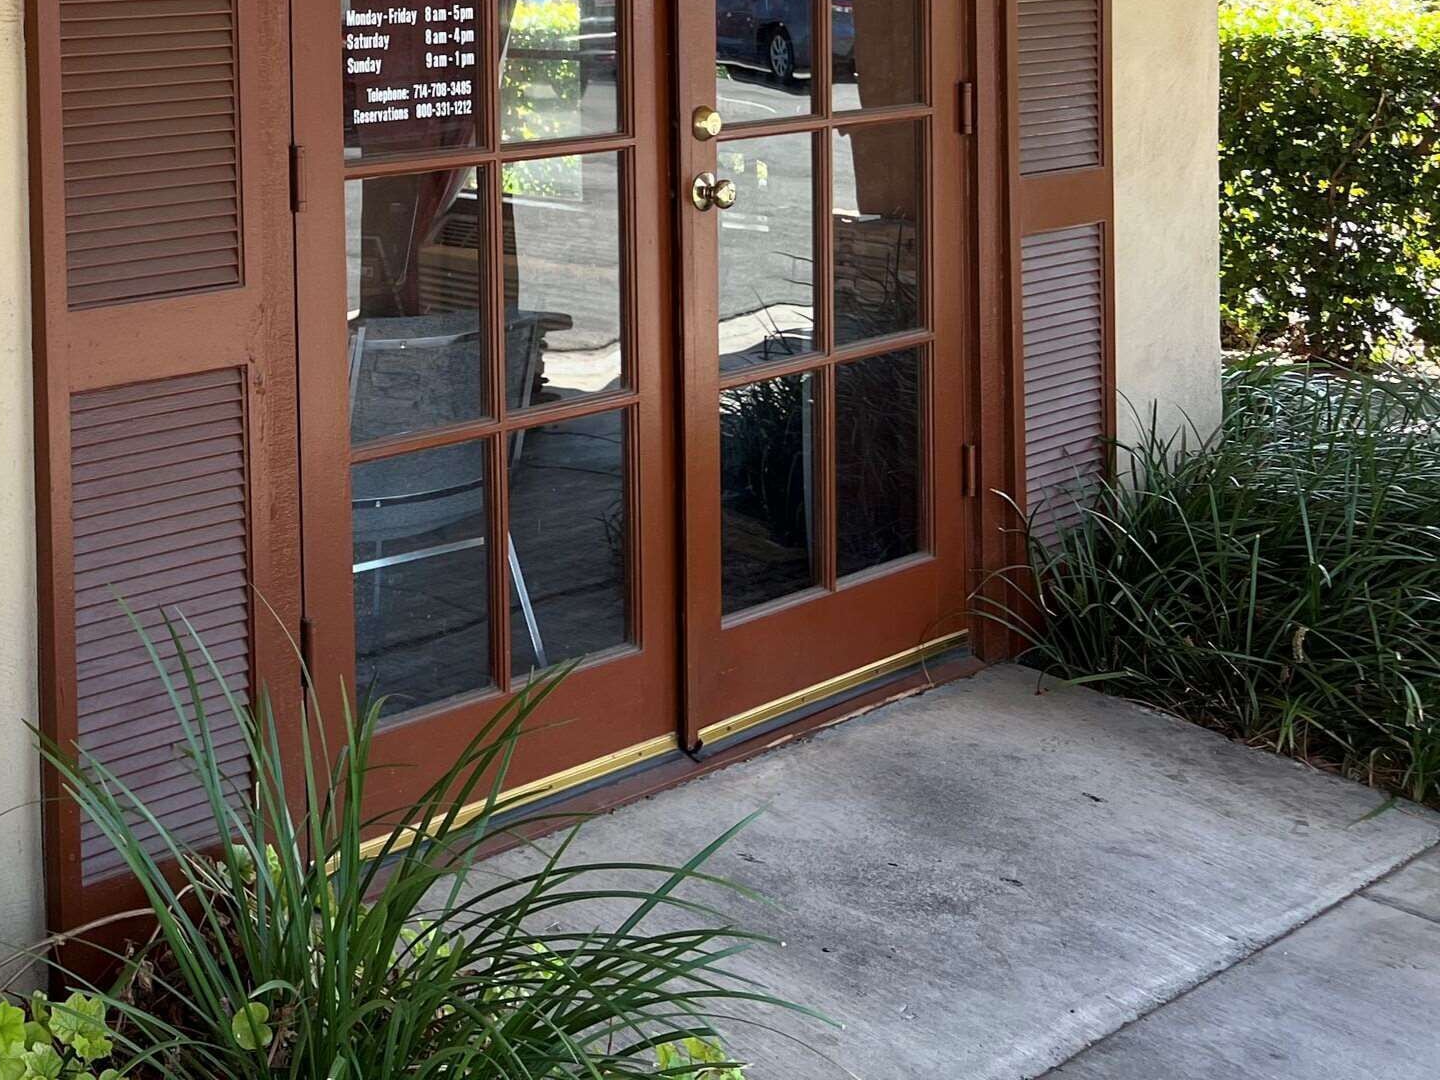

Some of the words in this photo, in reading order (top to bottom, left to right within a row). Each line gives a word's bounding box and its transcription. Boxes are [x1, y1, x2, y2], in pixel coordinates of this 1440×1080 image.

[346, 32, 390, 50] Saturday
[347, 56, 382, 74] Sunday
[366, 86, 410, 104] Telephone:
[353, 106, 409, 124] Reservations
[416, 99, 472, 118] 800-331-1212
